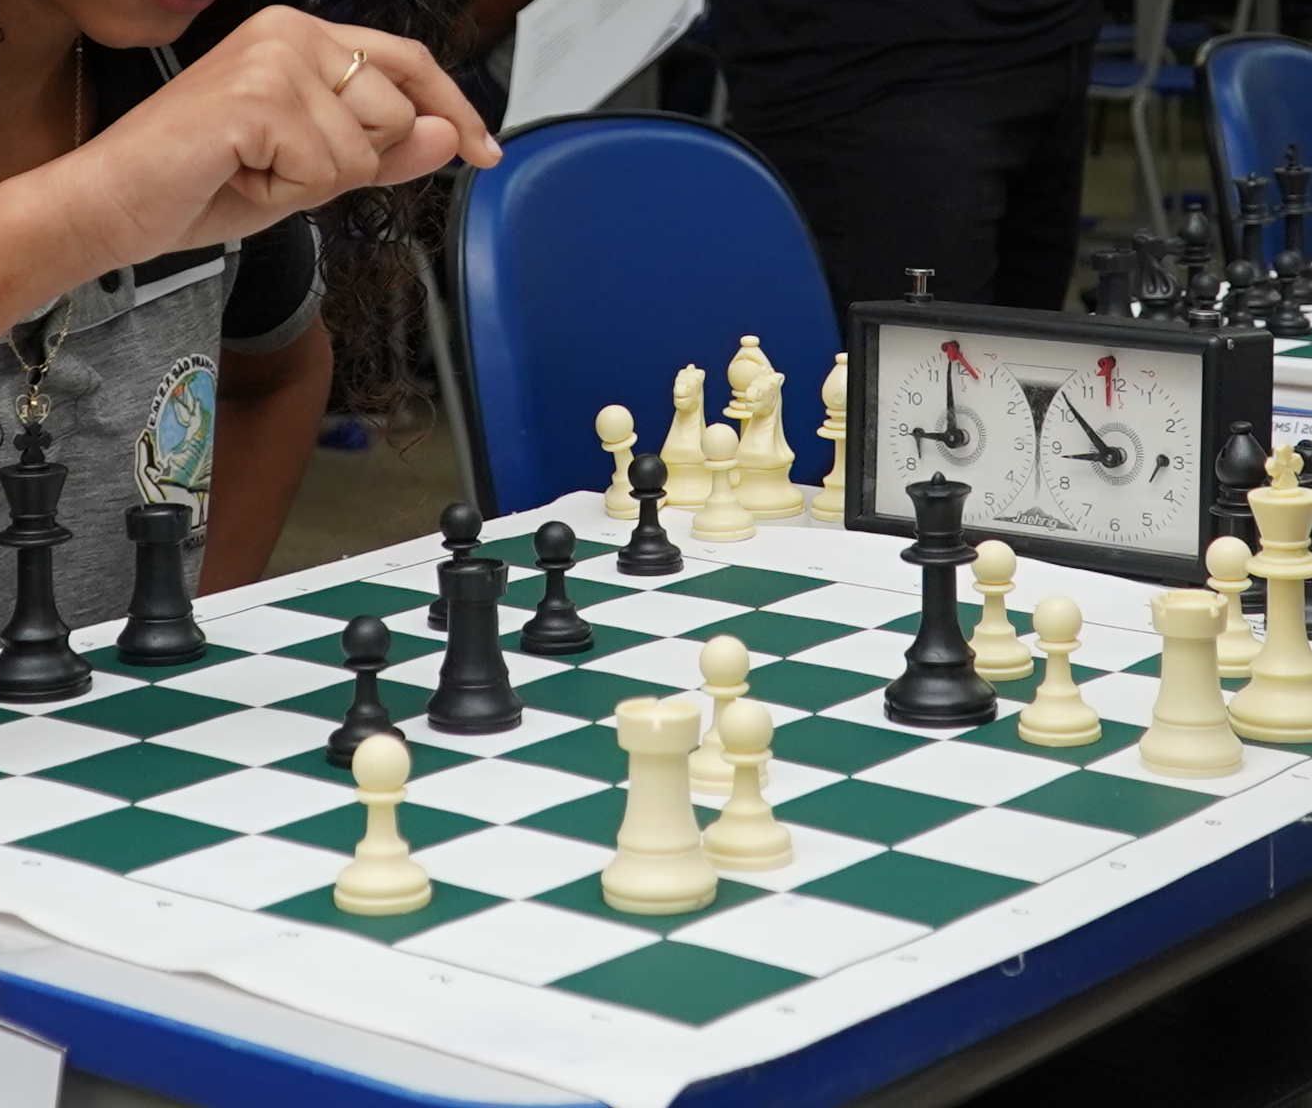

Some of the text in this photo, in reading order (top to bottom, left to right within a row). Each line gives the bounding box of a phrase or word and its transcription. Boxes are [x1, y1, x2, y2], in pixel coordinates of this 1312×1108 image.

[928, 369, 939, 383] 11
[1112, 378, 1127, 393] 12
[908, 392, 923, 406] 10
[1082, 386, 1094, 400] 11
[1007, 401, 1017, 415] 2
[1060, 408, 1077, 423] 10
[899, 423, 909, 437] 9
[1165, 418, 1176, 433] 2
[1014, 437, 1025, 451] 3
[1051, 441, 1063, 455] 9
[906, 457, 917, 471] 8
[1172, 455, 1185, 471] 3
[1004, 469, 1015, 483] 4
[1059, 476, 1071, 490] 8
[984, 492, 995, 506] 5
[1163, 490, 1175, 503] 4
[1082, 502, 1093, 517] 7
[1012, 510, 1059, 532] Jaehrig
[1109, 518, 1121, 532] 6
[1141, 512, 1153, 527] 5
